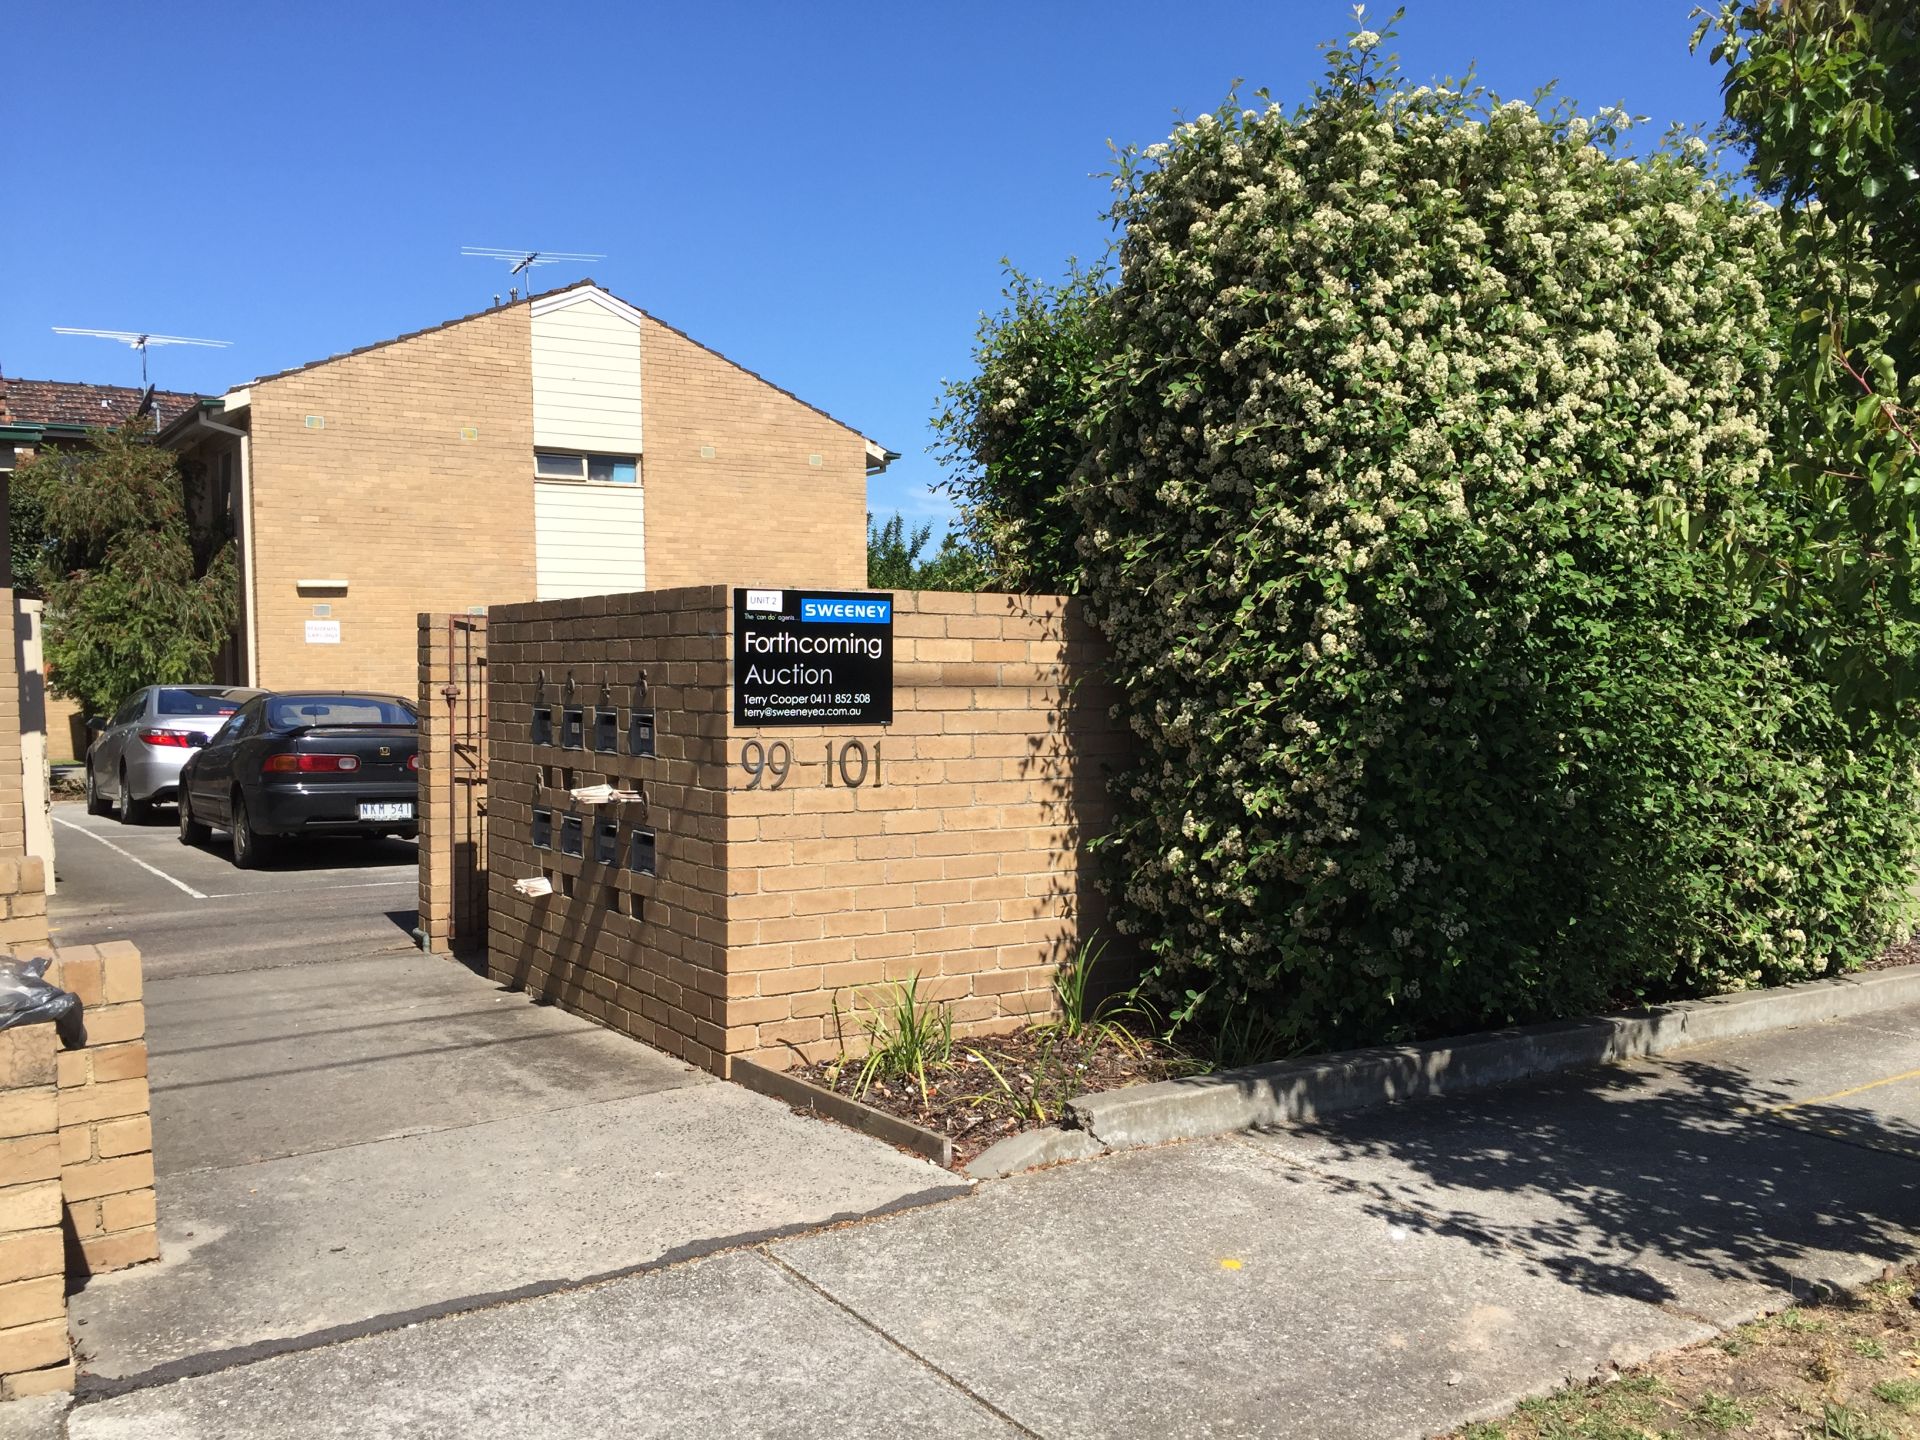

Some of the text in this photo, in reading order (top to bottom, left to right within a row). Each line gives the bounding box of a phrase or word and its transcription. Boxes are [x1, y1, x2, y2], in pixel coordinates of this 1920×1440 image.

[750, 596, 777, 605] UNIT 2
[805, 604, 886, 618] SWEENEY
[745, 632, 882, 659] Forthcoming
[744, 664, 833, 685] Auction
[744, 694, 870, 706] Terry Cooper 0411 852 508
[744, 707, 862, 718] terry@sweeneyea.com.au
[741, 740, 791, 790] 99
[825, 739, 881, 788] 101
[363, 803, 385, 815] NKM
